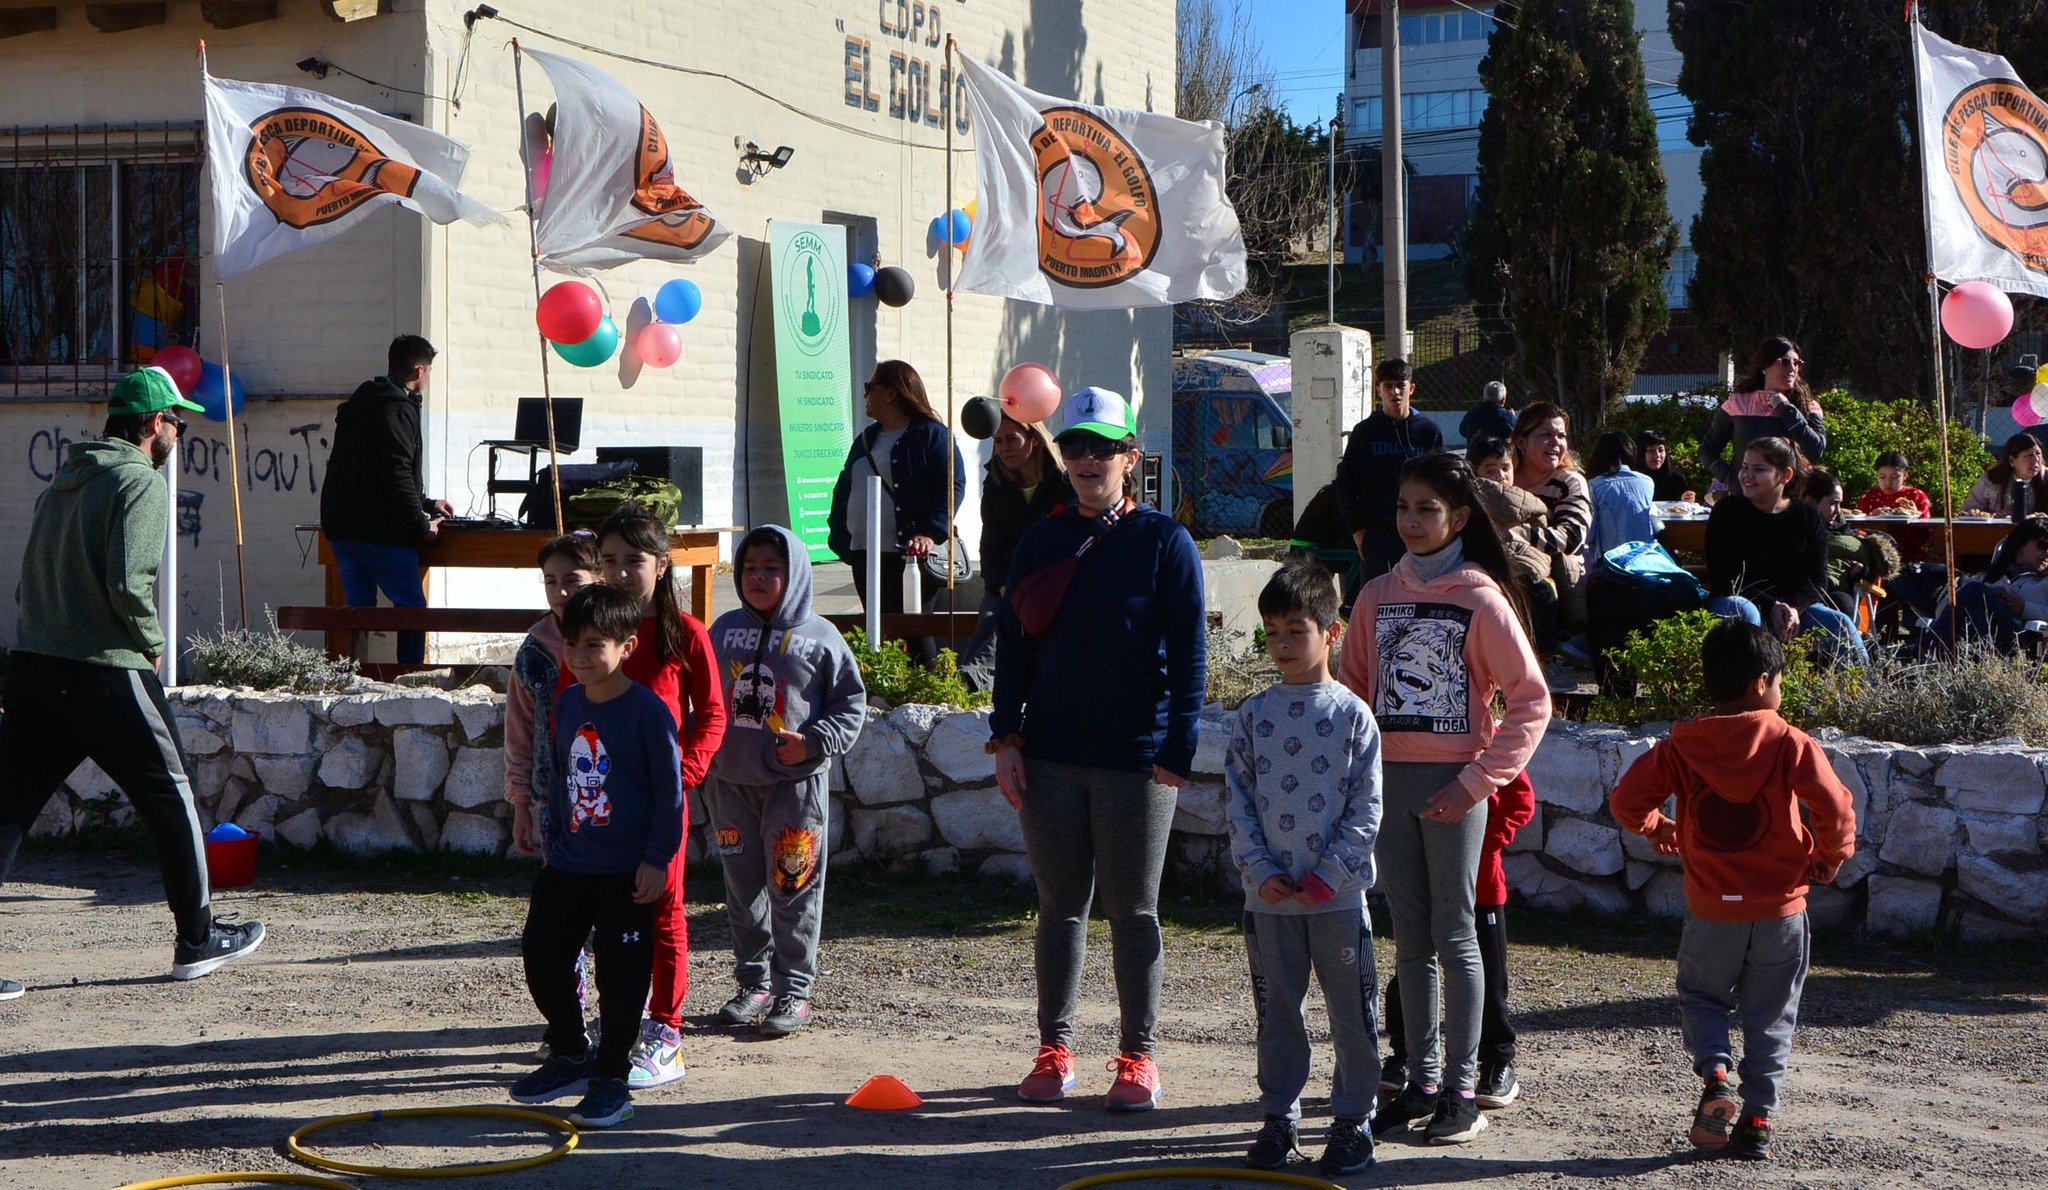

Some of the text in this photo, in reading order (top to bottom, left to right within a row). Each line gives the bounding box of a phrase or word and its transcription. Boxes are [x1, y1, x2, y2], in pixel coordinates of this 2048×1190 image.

[285, 118, 356, 147] DEPORTIVA
[1949, 138, 1960, 175] CLUB
[1958, 92, 1988, 124] PESCA
[1990, 91, 2048, 133] DEPORTIVA
[1053, 117, 1111, 151] DEPORTIVA
[1122, 166, 1146, 207] GOLFO
[316, 196, 350, 217] PUERTO
[794, 236, 822, 255] SEMM
[1044, 253, 1122, 278] PUERTO MADRYN
[802, 370, 834, 380] SINDICATO
[803, 397, 835, 406] SINDICATO
[789, 422, 844, 432] NUESTRO SINDICATO
[1377, 605, 1414, 618] HIMIKO
[1435, 719, 1466, 732] TOGA
